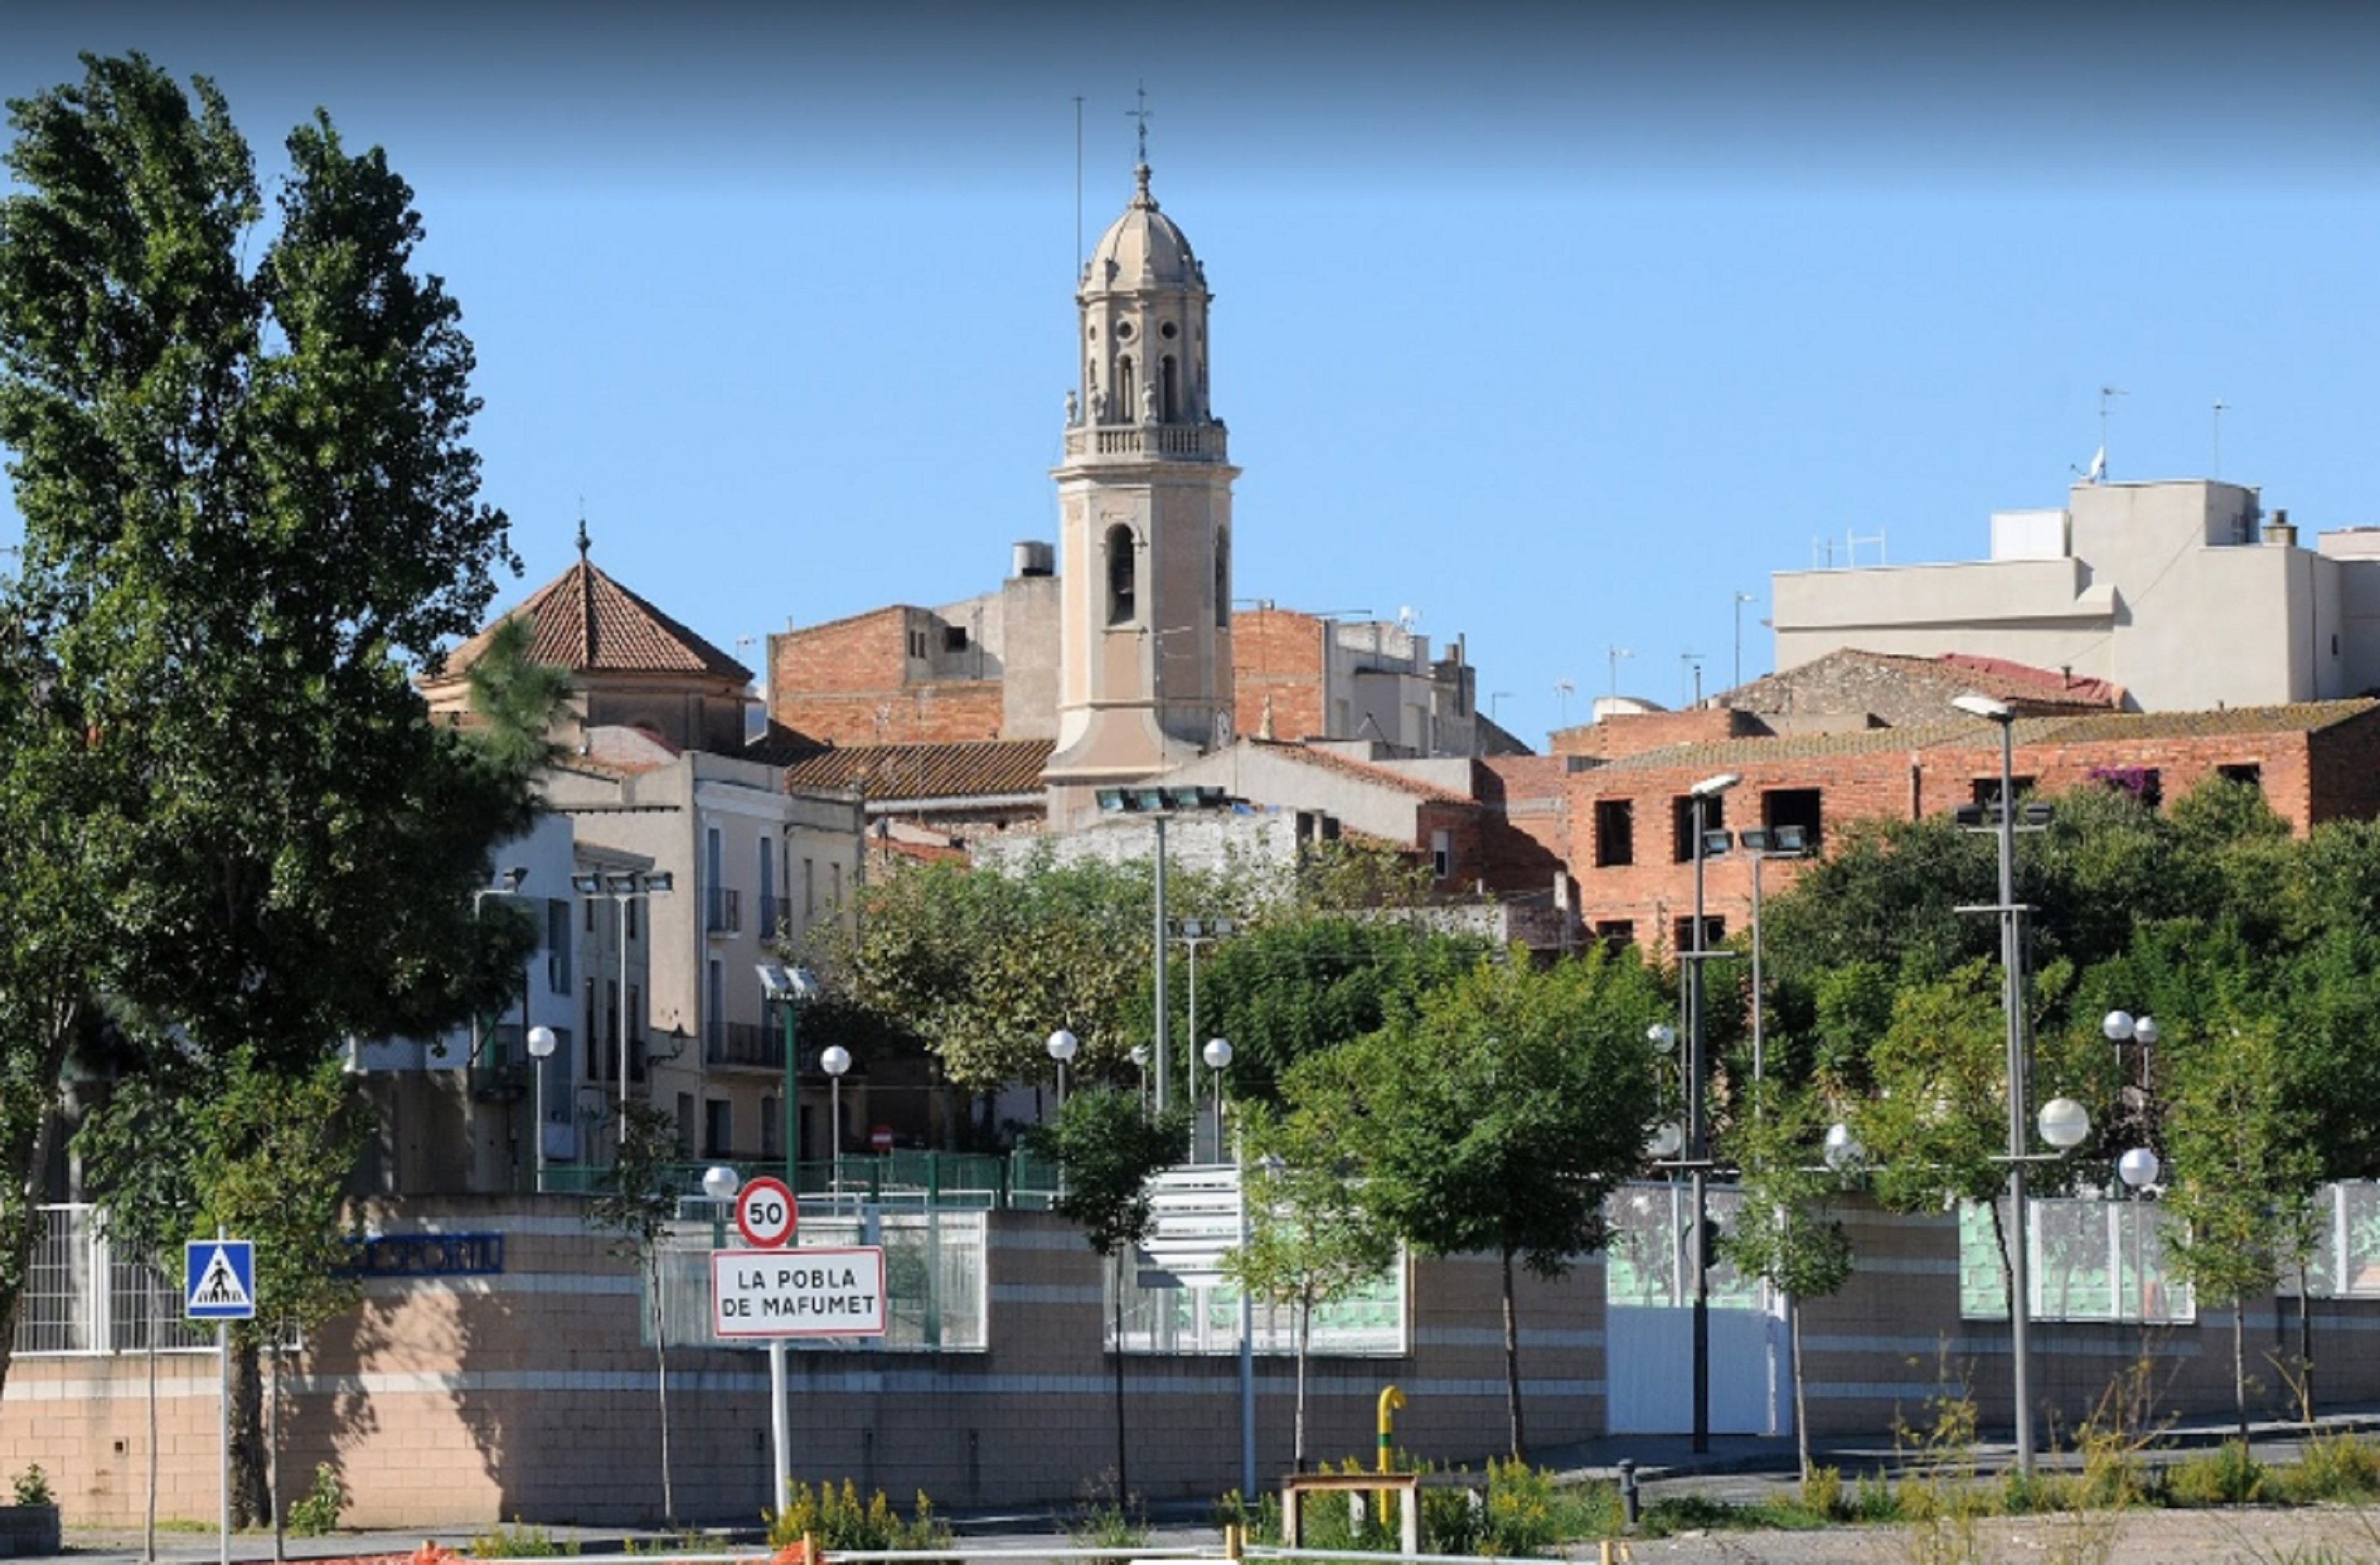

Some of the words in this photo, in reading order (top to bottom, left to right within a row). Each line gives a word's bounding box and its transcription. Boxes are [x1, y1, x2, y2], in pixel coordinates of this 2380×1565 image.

[750, 1202, 782, 1225] 50
[738, 1269, 766, 1290] LA
[777, 1268, 857, 1290] POBLA
[722, 1297, 752, 1318] DE
[762, 1295, 875, 1317] MAFUMET
